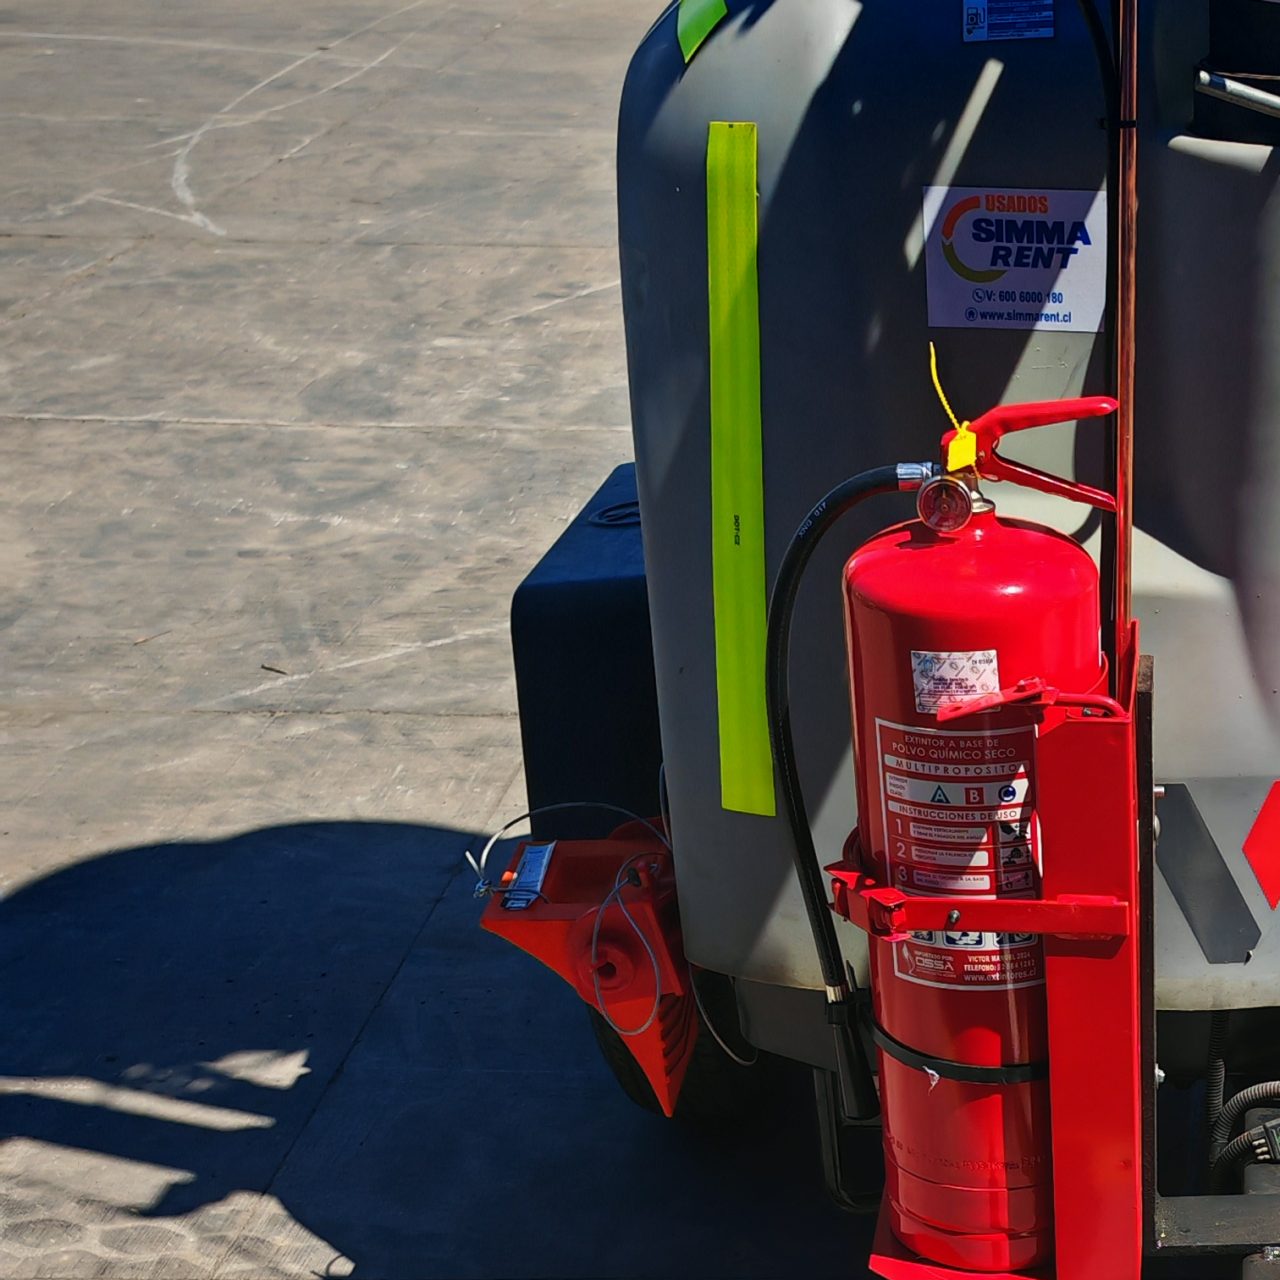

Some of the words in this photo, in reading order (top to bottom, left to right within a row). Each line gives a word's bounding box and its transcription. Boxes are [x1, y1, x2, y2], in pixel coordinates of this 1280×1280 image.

[985, 194, 1048, 214] USADOS
[971, 218, 1091, 246] SIMMA
[989, 246, 1079, 269] RENT
[985, 290, 996, 302] V:
[998, 291, 1017, 302] 600
[1019, 291, 1043, 303] 6000
[1046, 292, 1064, 304] 180
[980, 309, 1072, 323] www.simmarent.cl
[905, 734, 945, 747] EXTINTOR
[948, 740, 957, 748] A
[960, 740, 983, 748] BASE
[987, 739, 999, 748] DE
[892, 742, 926, 757] POLVO
[928, 745, 981, 760] QUÍMICO
[985, 747, 1016, 759] SECO
[895, 759, 1018, 775] MULTIPROPOSITO
[899, 805, 976, 820] INSTRUCCIONES
[980, 811, 993, 820] DE
[995, 810, 1017, 820] USO
[895, 819, 902, 834] 1
[896, 842, 906, 858] 2
[898, 866, 908, 880] 3
[915, 956, 954, 971] OSSA
